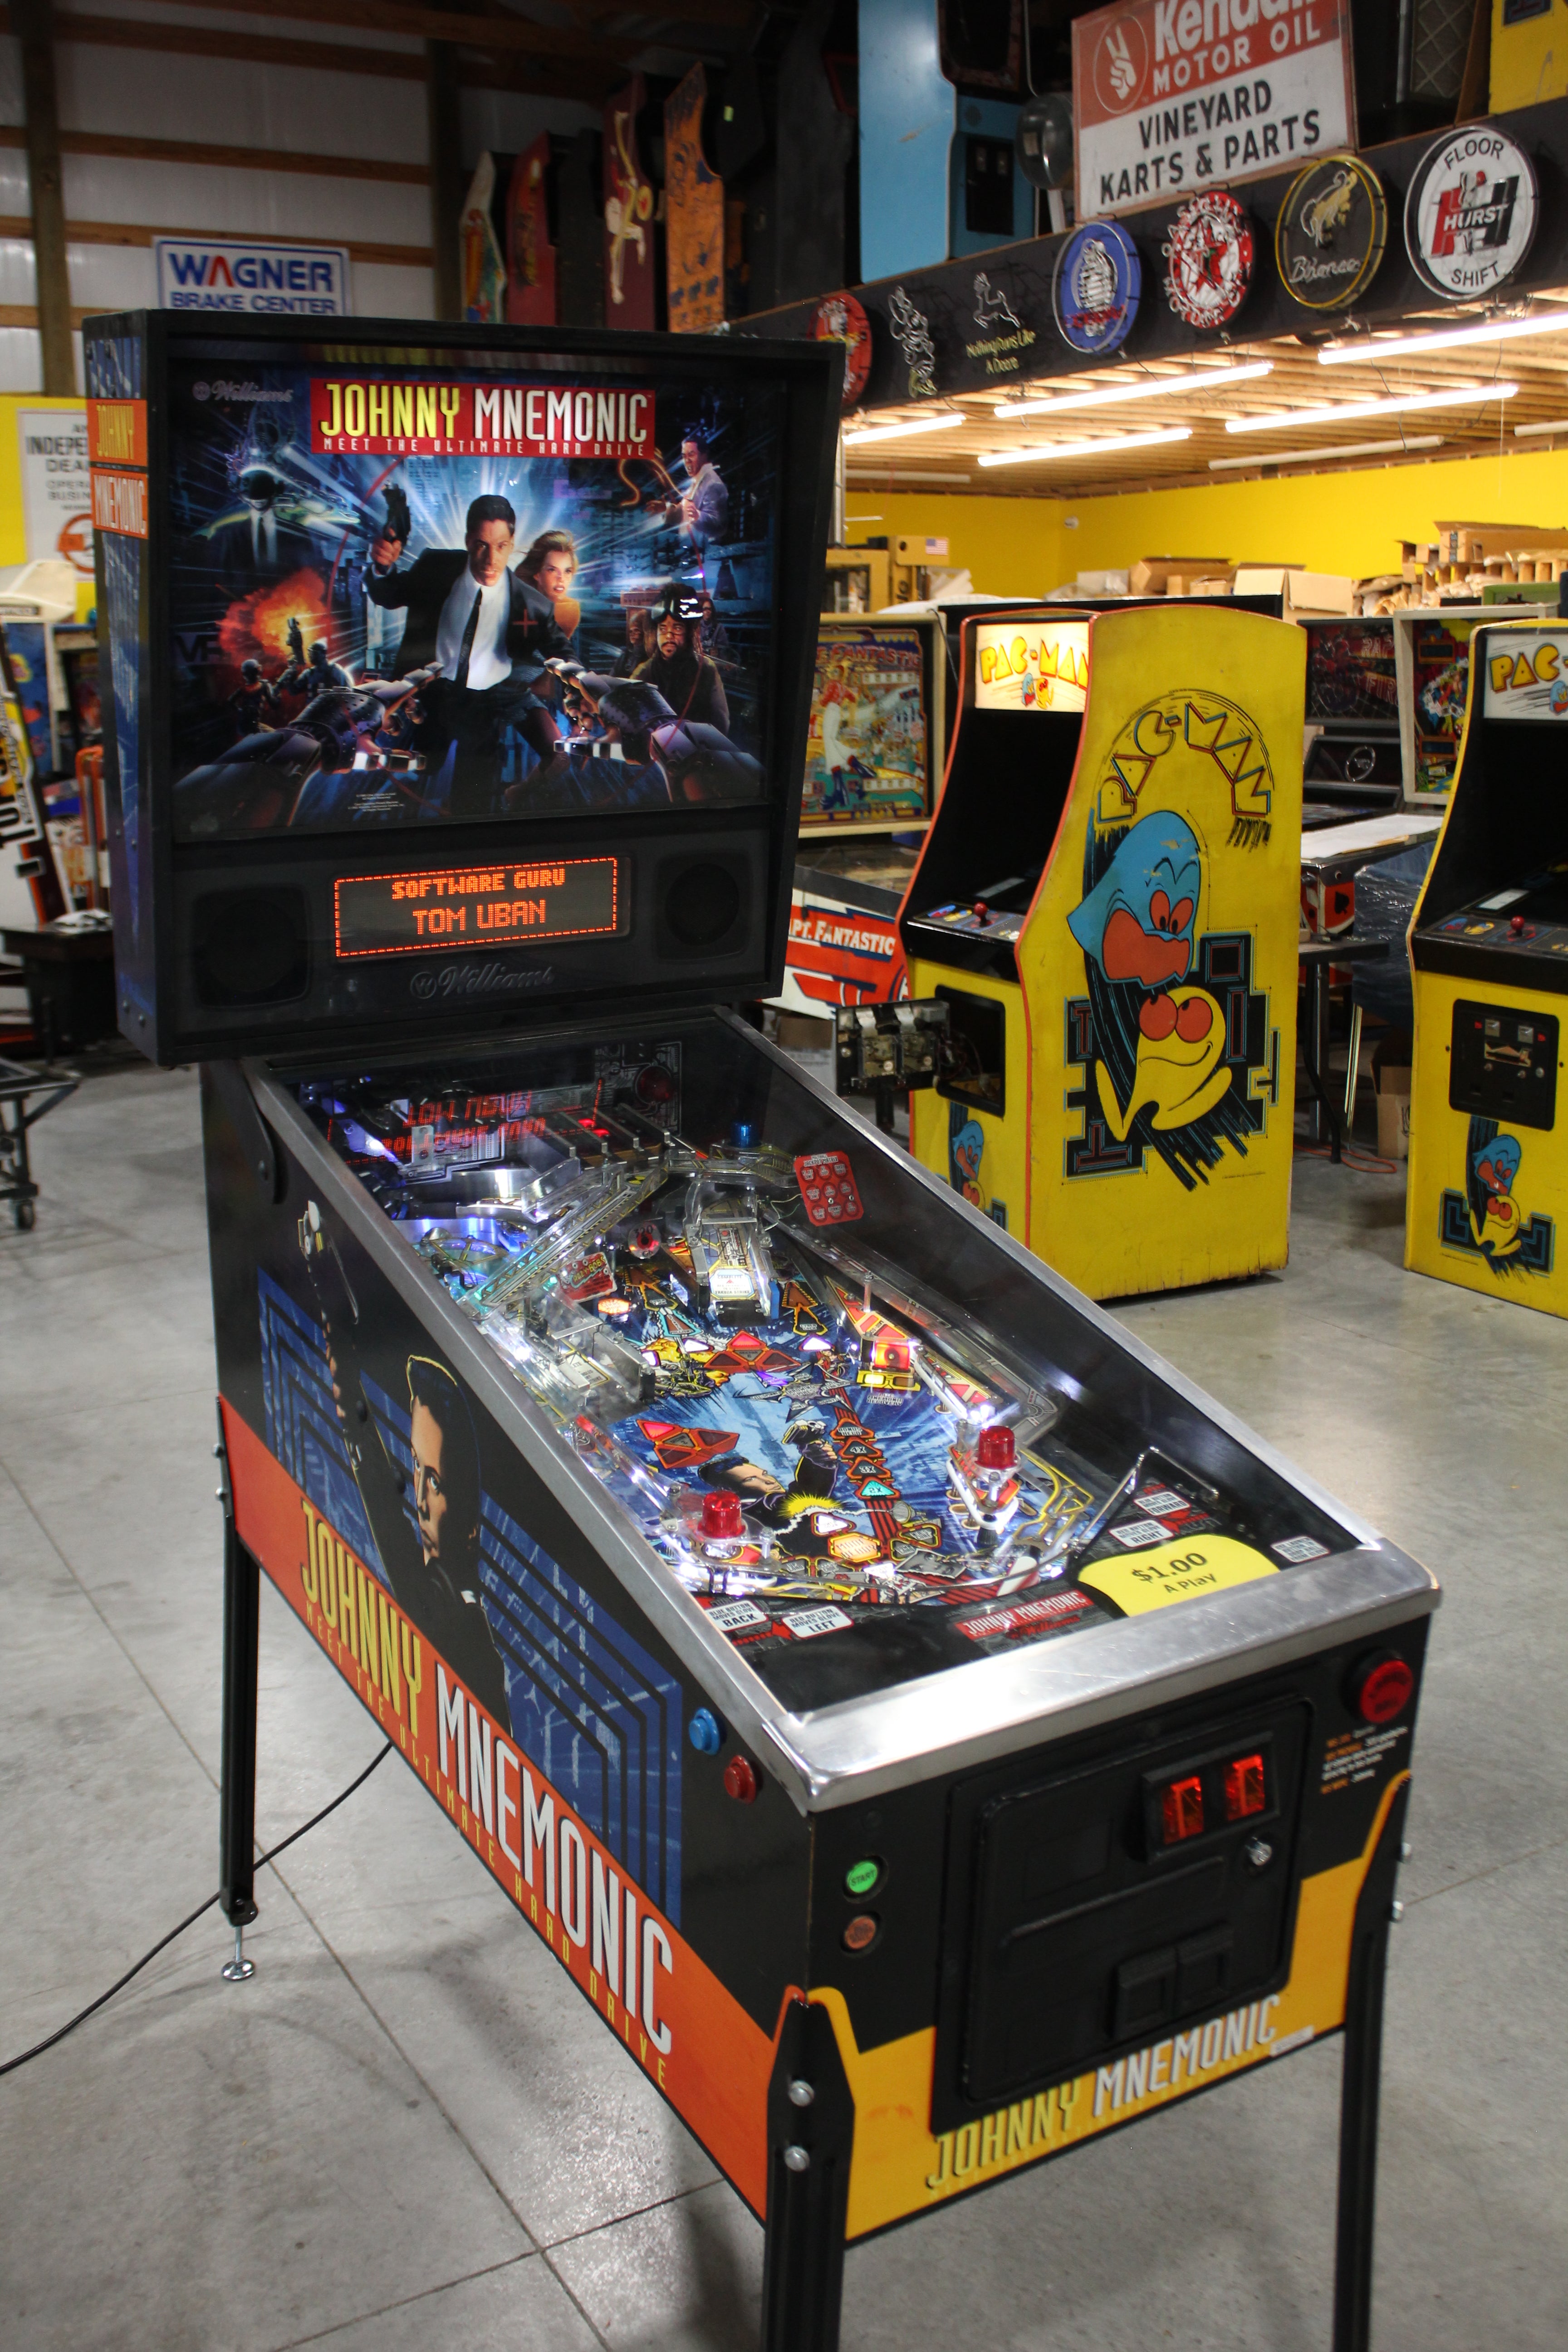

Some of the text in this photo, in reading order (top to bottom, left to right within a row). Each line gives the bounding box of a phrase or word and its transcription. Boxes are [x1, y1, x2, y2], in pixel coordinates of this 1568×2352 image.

[1153, 10, 1320, 96] MOTOR OIL
[1139, 79, 1272, 149] VINEYARD
[1100, 110, 1320, 205] KARTS & PARTS
[1444, 137, 1504, 170] FLOOR
[1444, 203, 1509, 231] HURST
[169, 253, 333, 292] WAGNER
[1451, 263, 1499, 287] SHIFT
[170, 292, 335, 314] BRAKE CENTER
[321, 384, 647, 443] JOHNNY MNEMONIC
[324, 438, 644, 456] MEET THE ULTIMATE HARD DRIVE
[1098, 701, 1271, 824] PAC-MAN
[392, 868, 565, 900] SOFTWARE GURU
[412, 899, 545, 935] TOM UBAN
[815, 920, 896, 956] FANTASTIC
[439, 963, 554, 996] Williams
[1148, 1500, 1188, 1514] FORWARD
[1130, 1531, 1163, 1544] RIGHT
[1132, 1553, 1208, 1583] $1.00
[1163, 1573, 1218, 1594] A Play
[709, 1602, 751, 1617] BLUE BUTTON
[713, 1606, 755, 1621] MOVES GLOVE
[722, 1613, 759, 1627] BACK
[789, 1608, 834, 1623] RED BUTTON
[790, 1612, 842, 1629] MOVES GLOVE
[963, 1611, 1017, 1635] JOHNNY
[1014, 1592, 1087, 1620] MNEMONIC
[808, 1620, 837, 1633] LEFT
[301, 1499, 672, 2055] JOHNNY MNEMONIC
[306, 1600, 666, 2090] MEET THE ULTIMATE HARD DRIVE
[851, 1869, 876, 1886] START
[926, 1994, 1280, 2189] JOHNNY MNEMONIC
